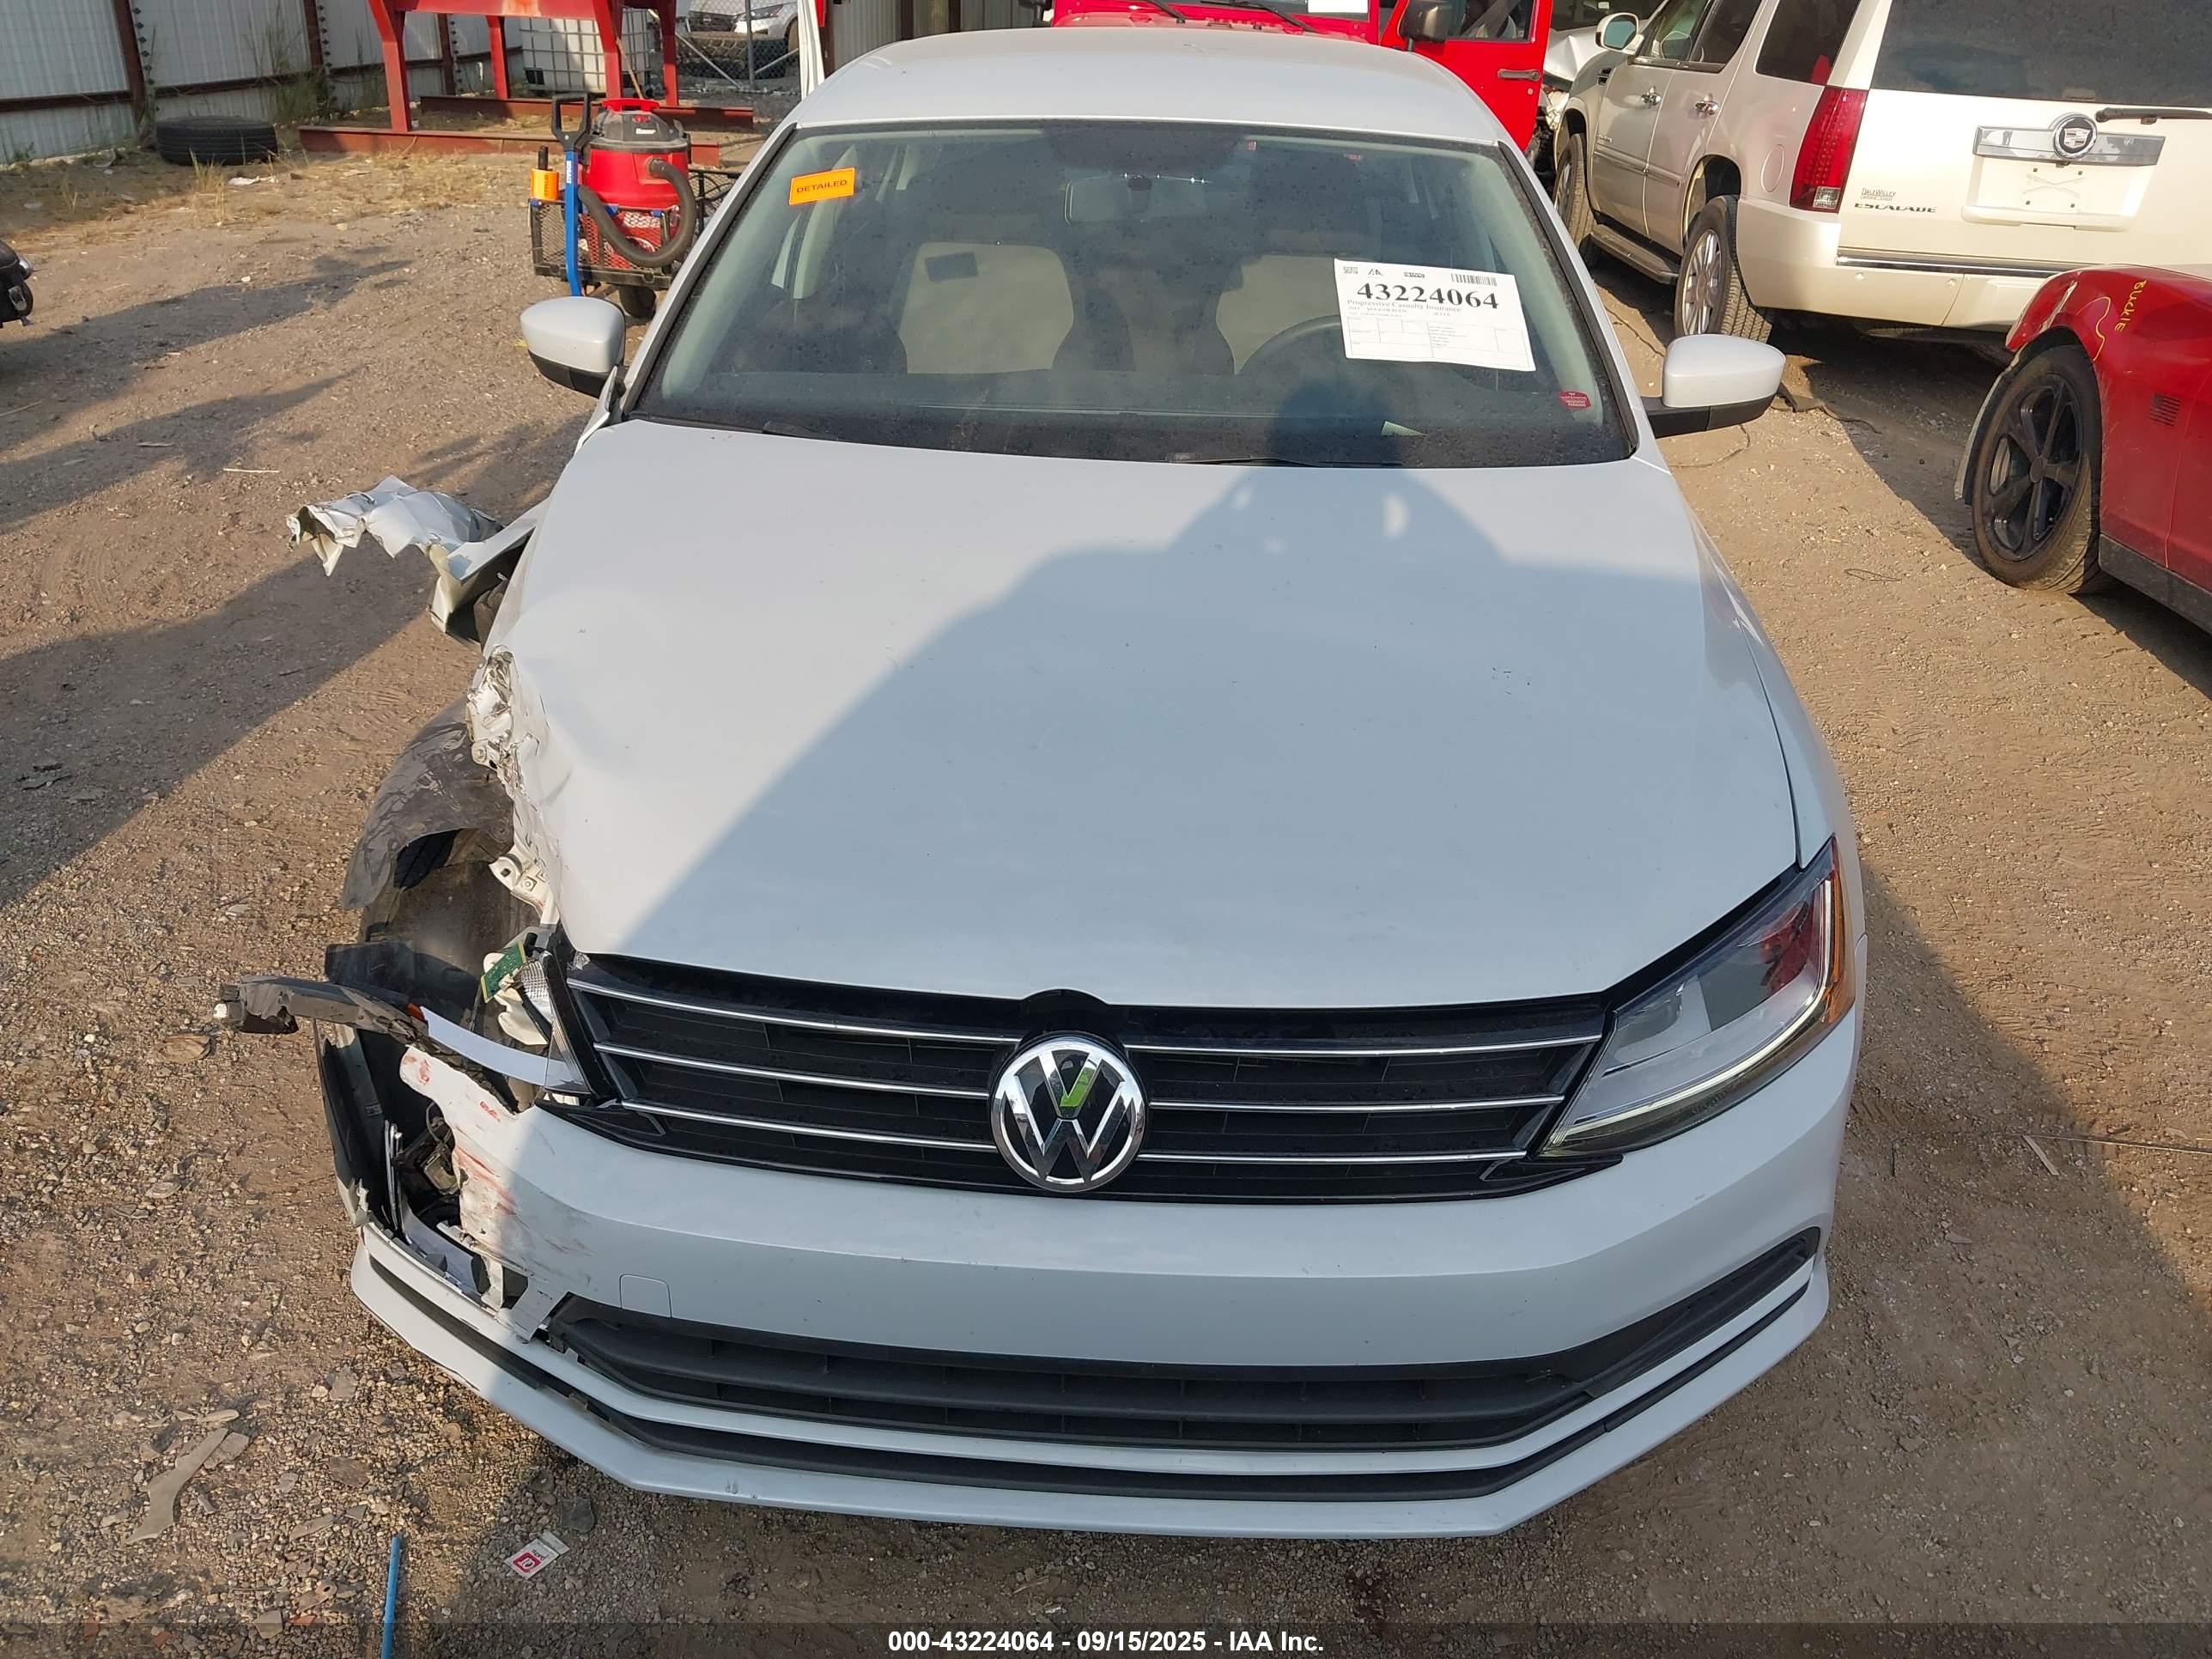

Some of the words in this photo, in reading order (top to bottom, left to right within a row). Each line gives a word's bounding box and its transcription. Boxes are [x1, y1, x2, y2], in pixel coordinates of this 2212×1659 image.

[796, 179, 848, 193] DETAILED
[1854, 203, 1937, 213] ESCALADE
[1357, 283, 1499, 309] 43224064
